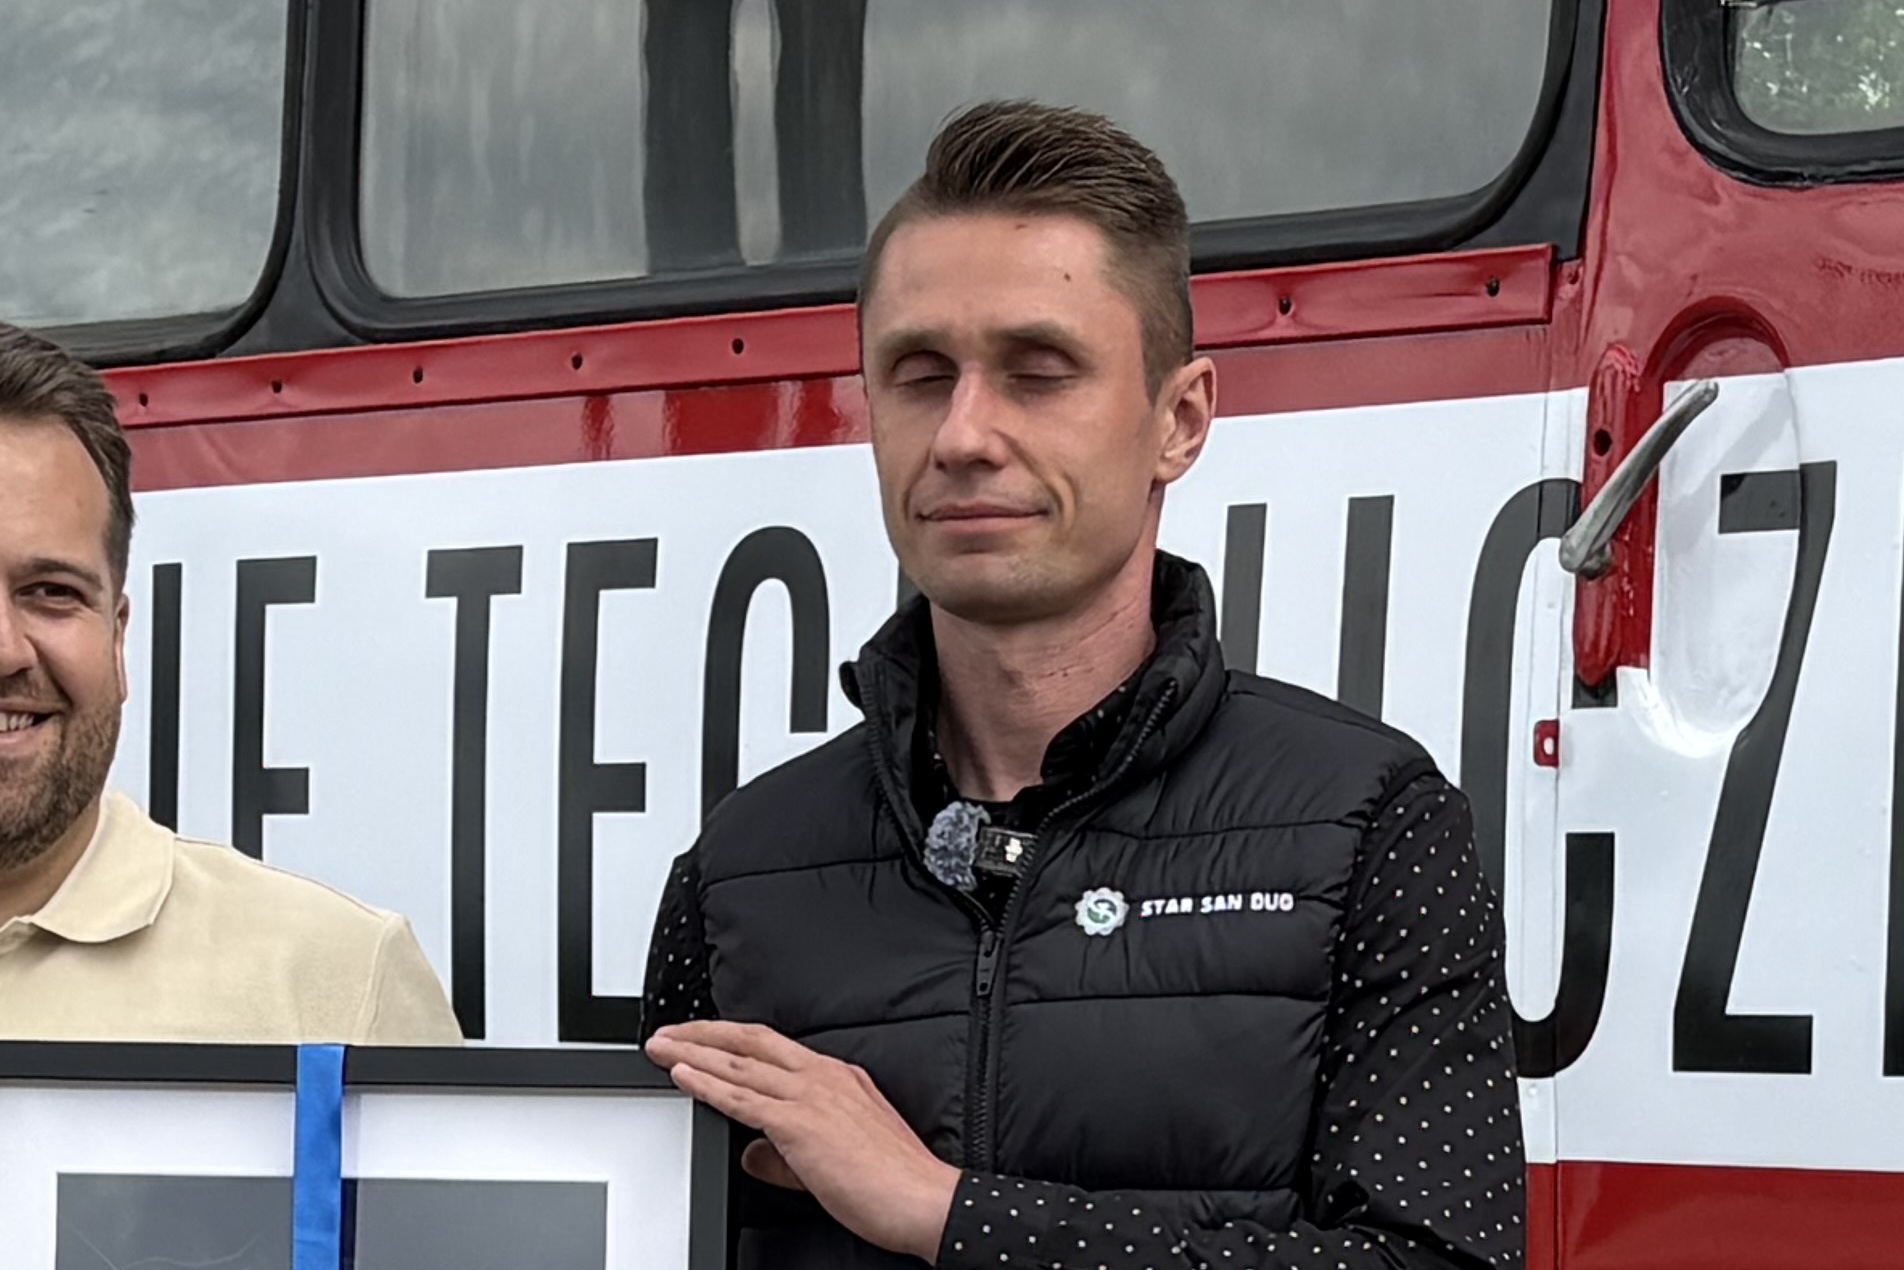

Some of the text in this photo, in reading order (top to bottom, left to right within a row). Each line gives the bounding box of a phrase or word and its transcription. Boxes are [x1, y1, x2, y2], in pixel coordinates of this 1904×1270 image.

[1141, 891, 1295, 917] STAR SAN DUO
